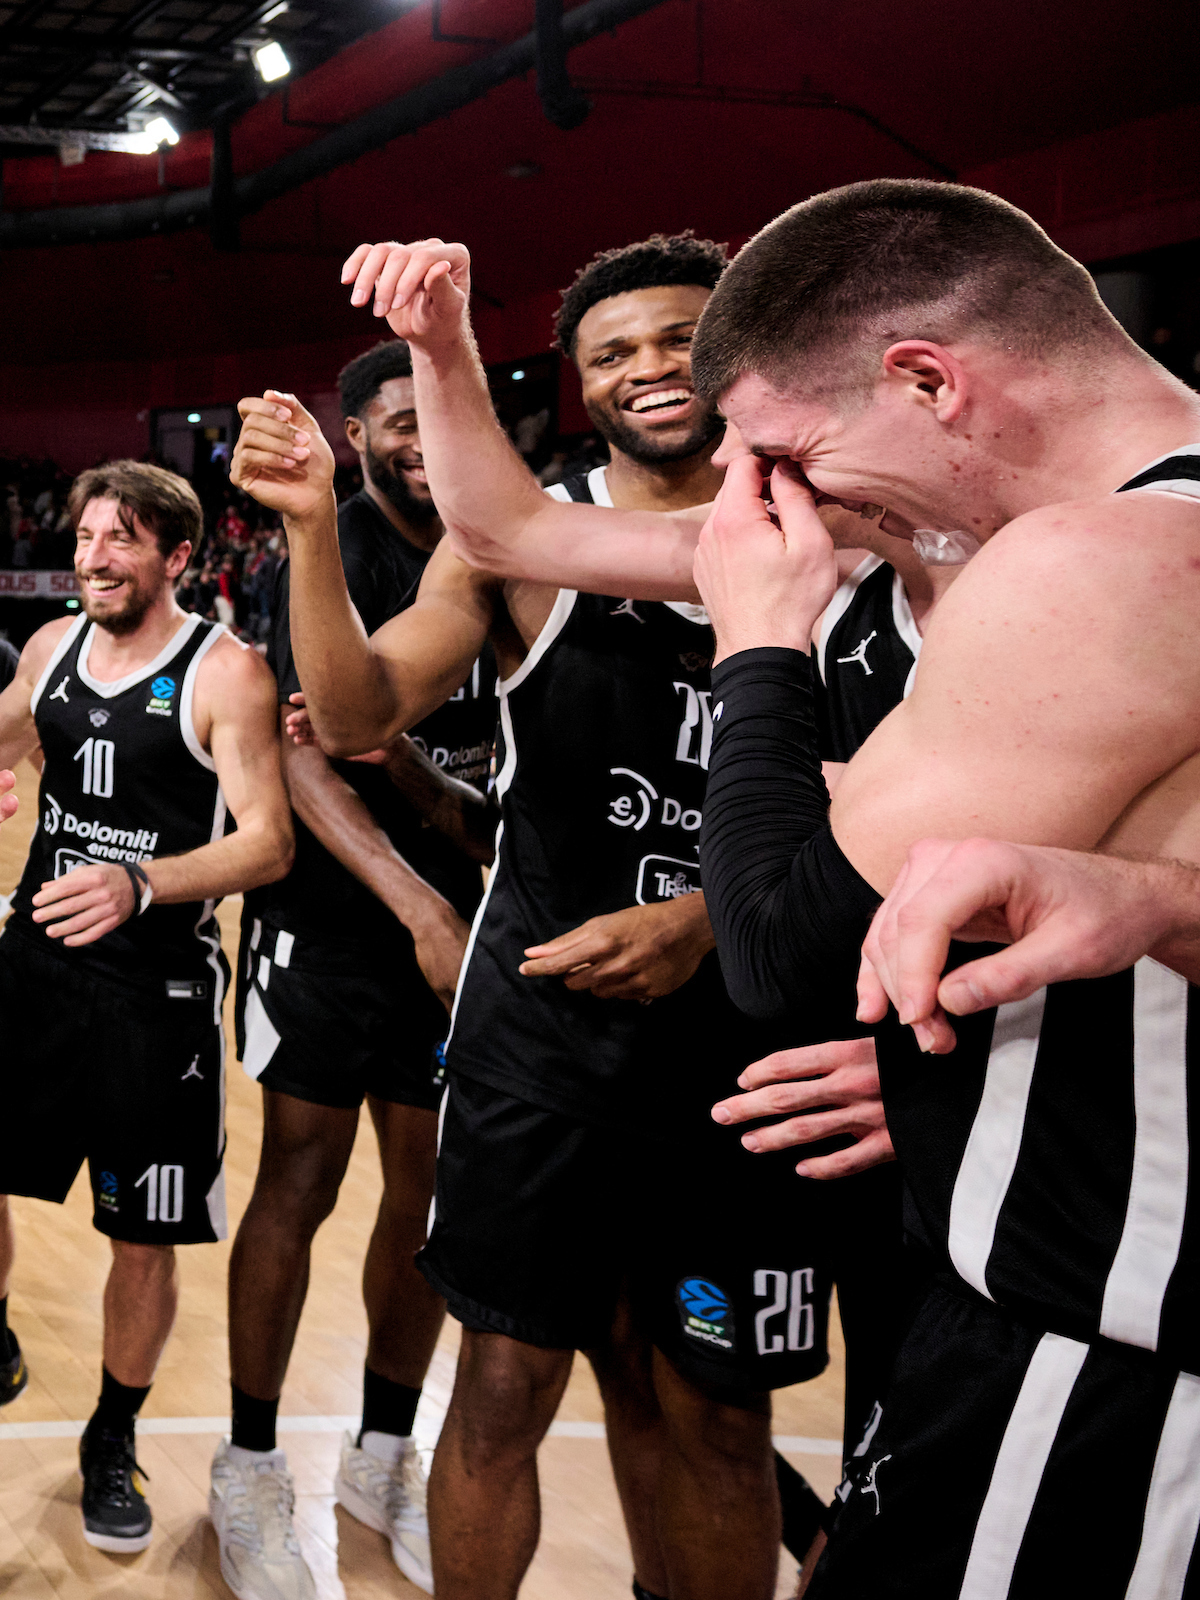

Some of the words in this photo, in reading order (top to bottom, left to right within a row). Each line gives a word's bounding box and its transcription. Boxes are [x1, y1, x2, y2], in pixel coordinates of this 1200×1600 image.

[73, 737, 115, 799] 10
[62, 812, 160, 852] Dolomiti
[134, 1163, 185, 1223] 10
[753, 1267, 815, 1356] 26
